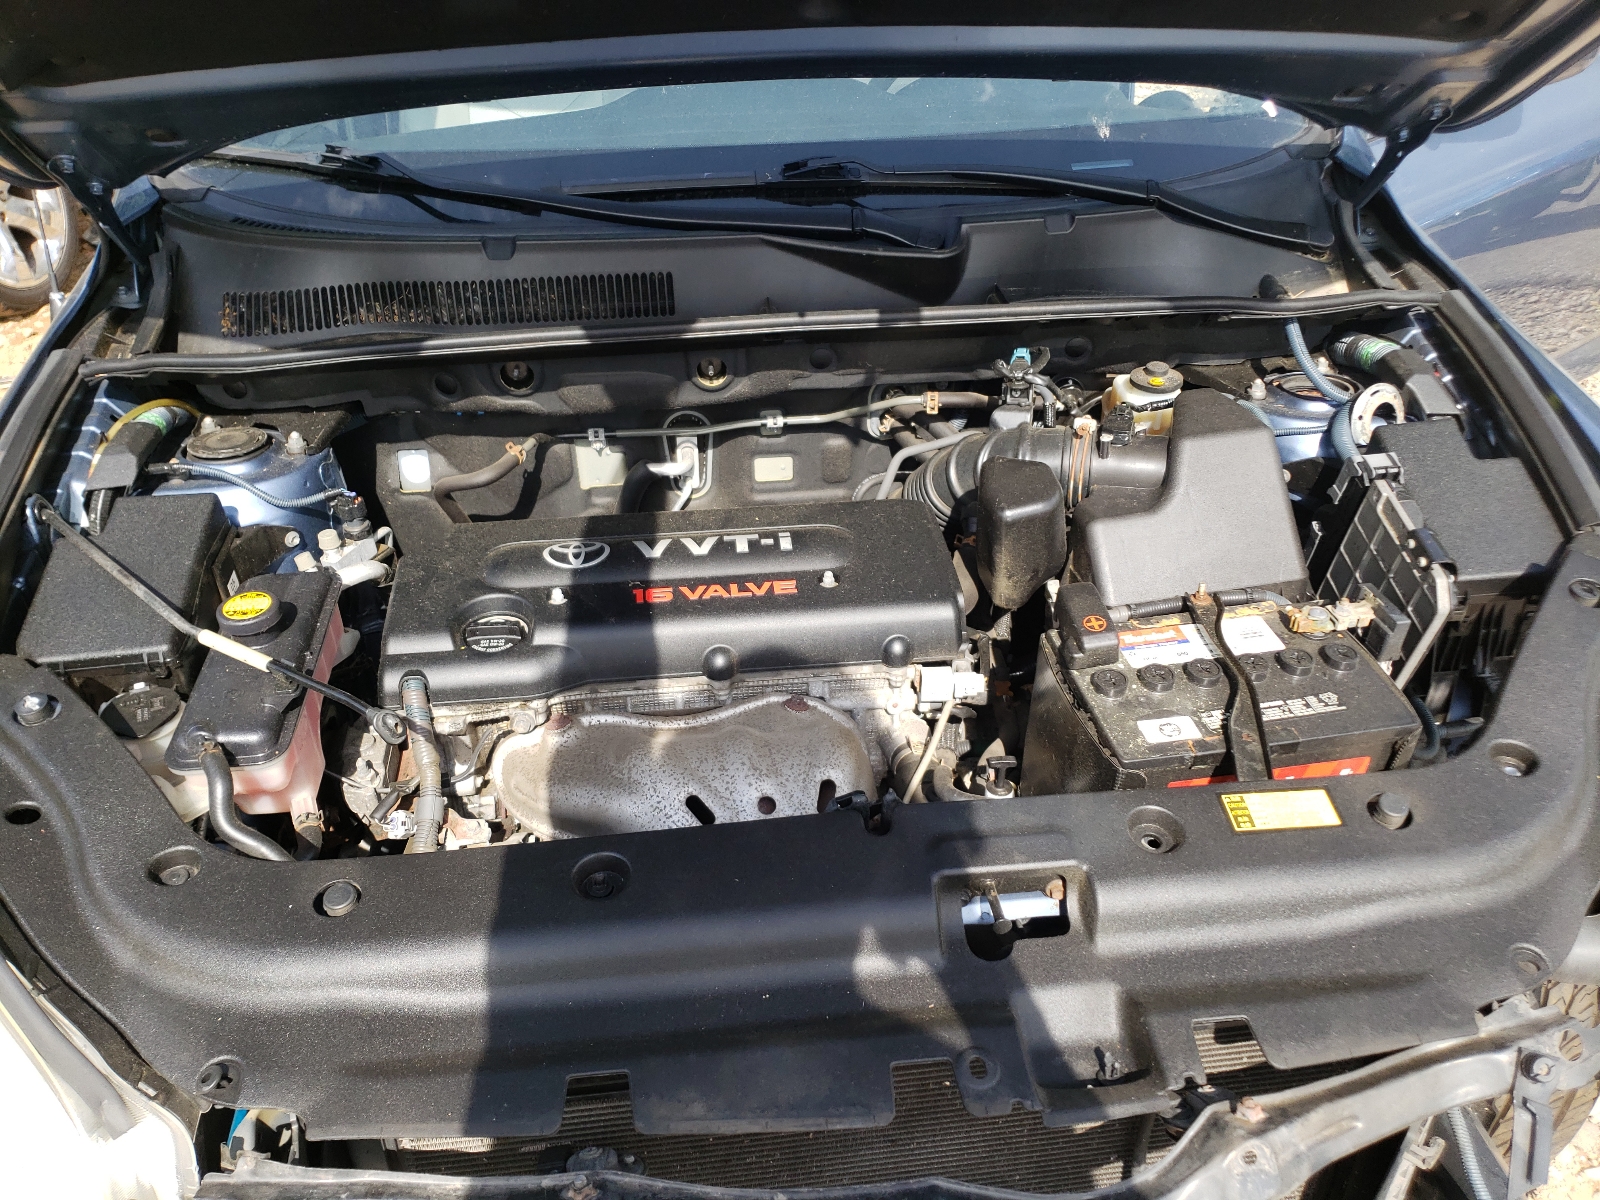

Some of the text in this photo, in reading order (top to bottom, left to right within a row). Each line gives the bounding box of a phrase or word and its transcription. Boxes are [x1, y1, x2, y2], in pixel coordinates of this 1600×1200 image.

[632, 532, 793, 558] VVT-i
[632, 579, 798, 604] 16 VALVE
